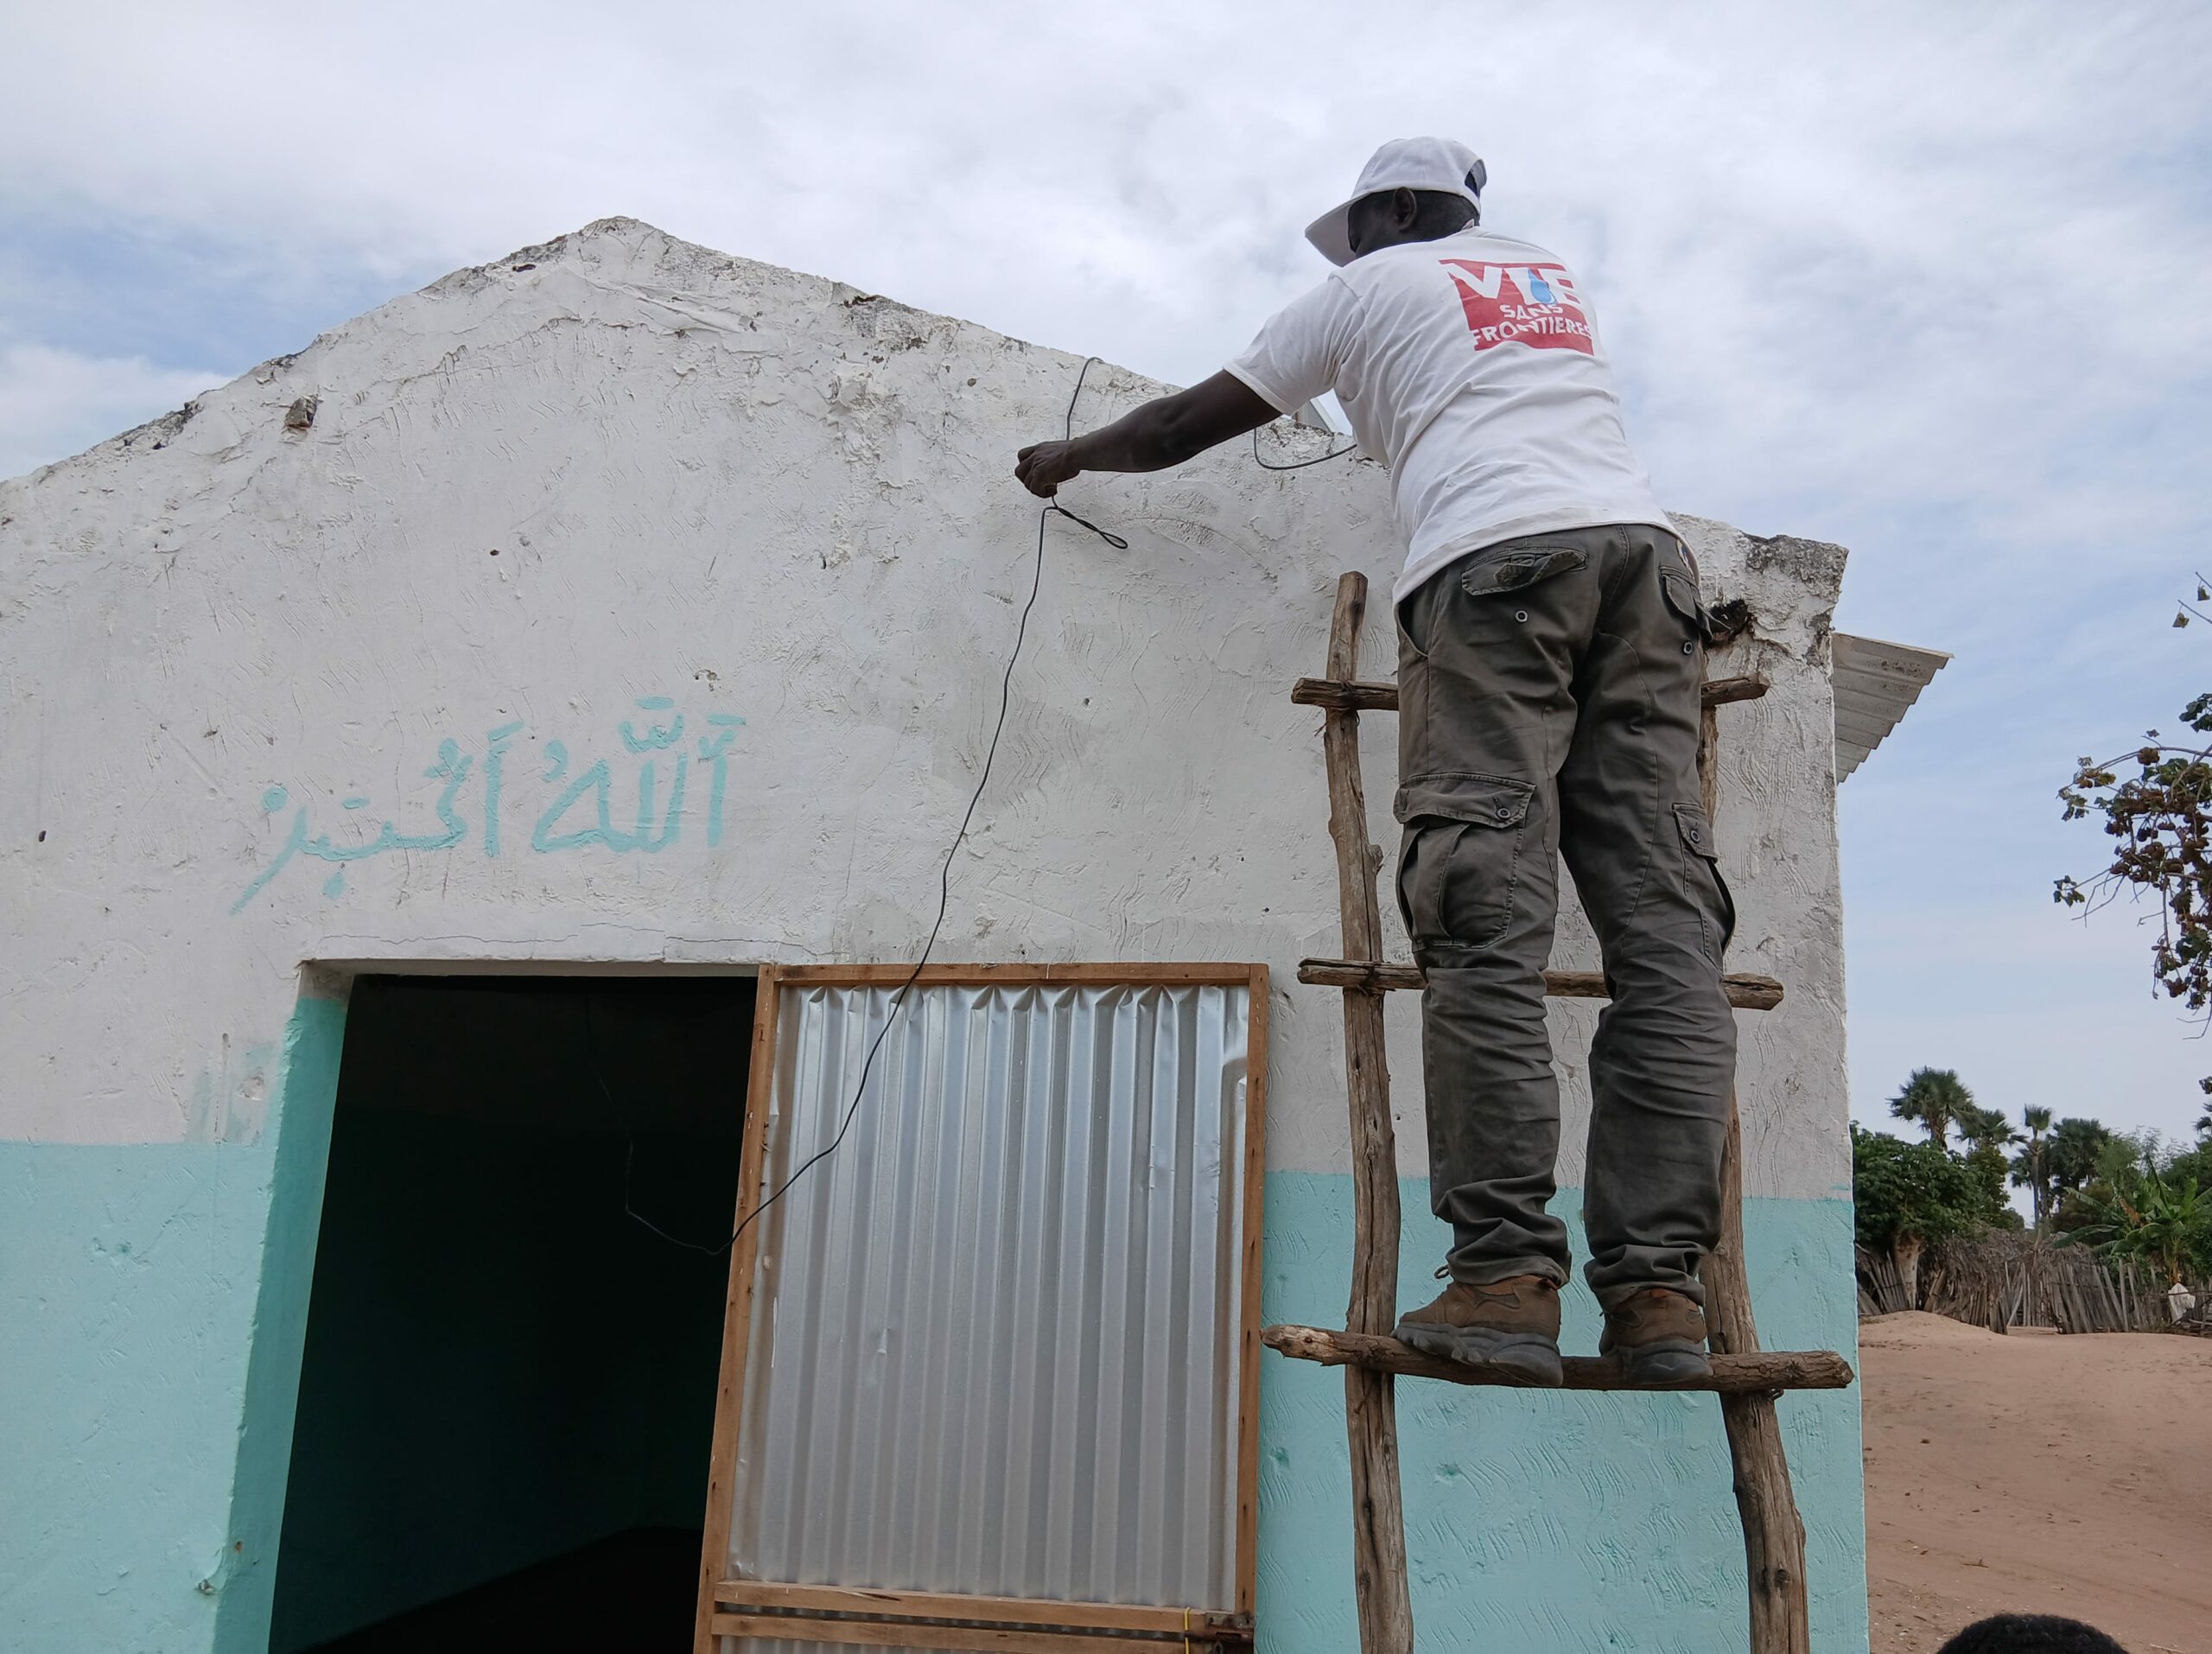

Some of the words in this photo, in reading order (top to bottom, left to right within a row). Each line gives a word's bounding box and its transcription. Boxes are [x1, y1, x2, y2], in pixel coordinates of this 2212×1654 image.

[1440, 263, 1582, 305] VIE
[1498, 303, 1564, 321] SANS
[1471, 316, 1592, 346] FRONTIERES
